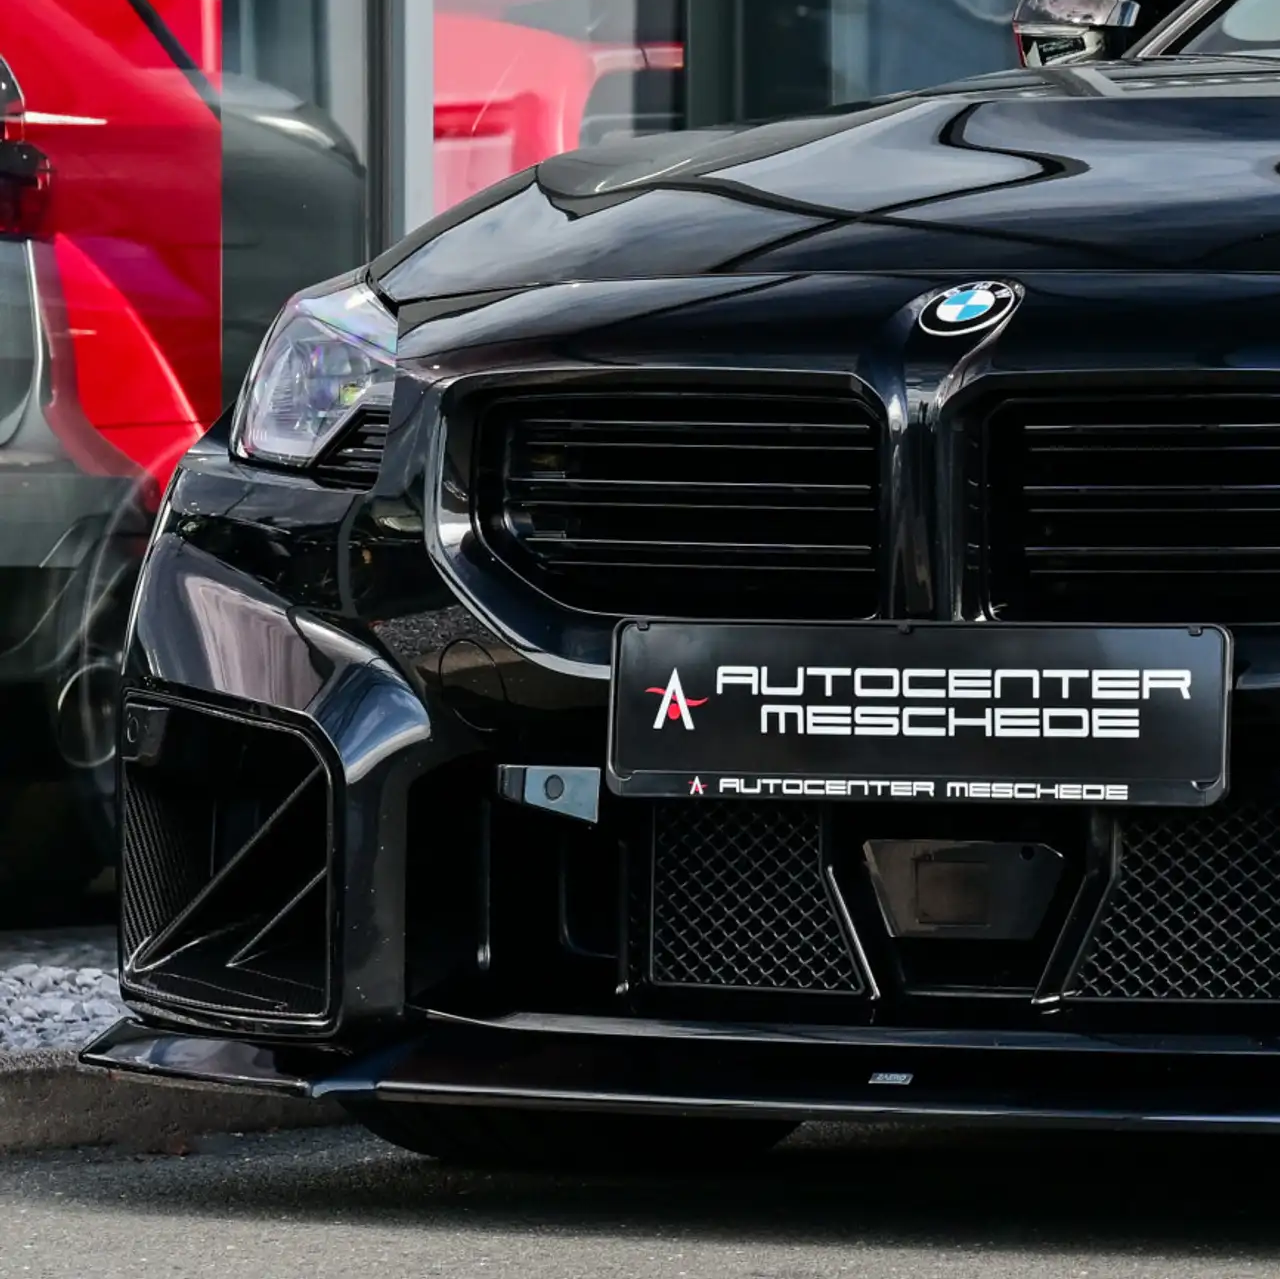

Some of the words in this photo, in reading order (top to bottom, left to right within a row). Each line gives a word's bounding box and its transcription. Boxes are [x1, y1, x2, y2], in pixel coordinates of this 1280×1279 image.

[715, 666, 1193, 700] AUTOCENTER
[760, 704, 1140, 739] MESCHEDE
[718, 777, 935, 797] AUTOCENTER
[946, 780, 1129, 801] MESCHEDE
